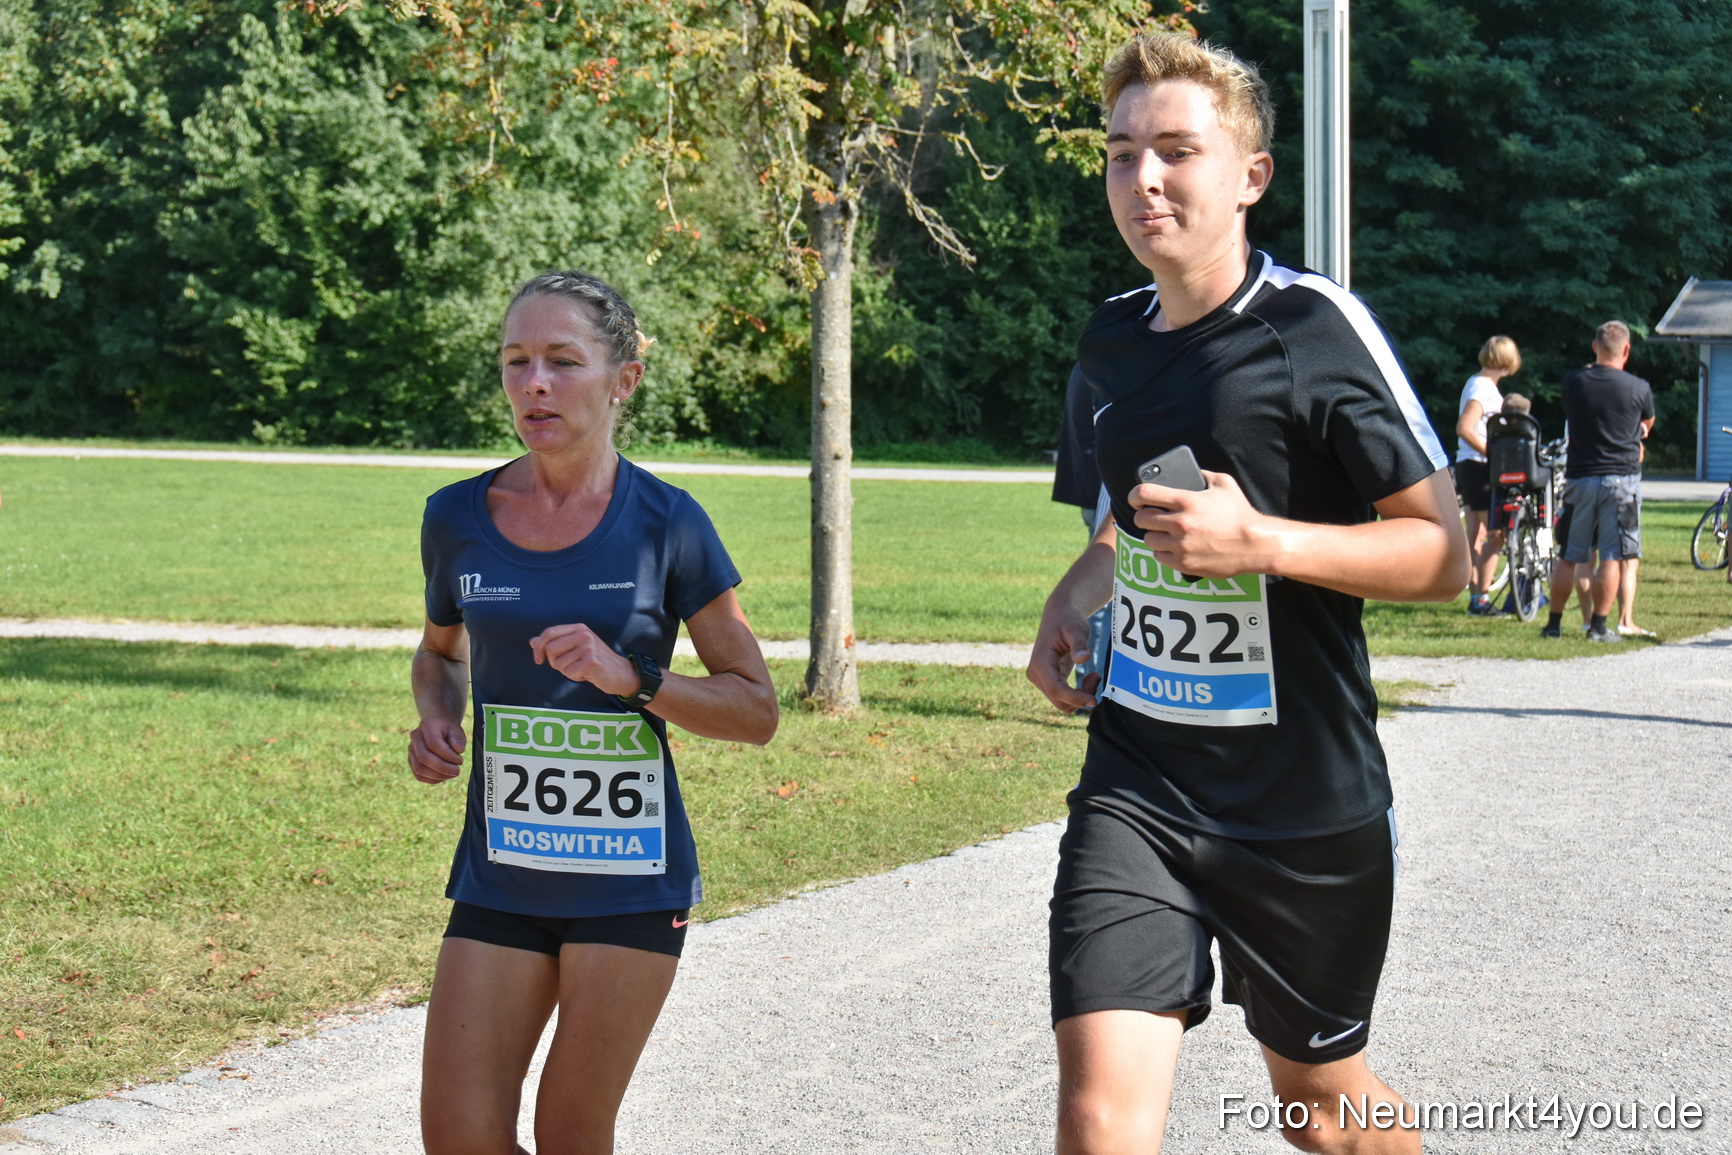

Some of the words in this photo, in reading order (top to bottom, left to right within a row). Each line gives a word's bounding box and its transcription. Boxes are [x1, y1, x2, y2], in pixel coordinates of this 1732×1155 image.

[1120, 595, 1244, 664] 2622
[1248, 616, 1257, 626] C
[1138, 671, 1213, 704] LOUIS
[498, 715, 643, 753] BOCK
[503, 764, 644, 818] 2626
[647, 773, 655, 783] D
[502, 827, 644, 855] ROSWITHA
